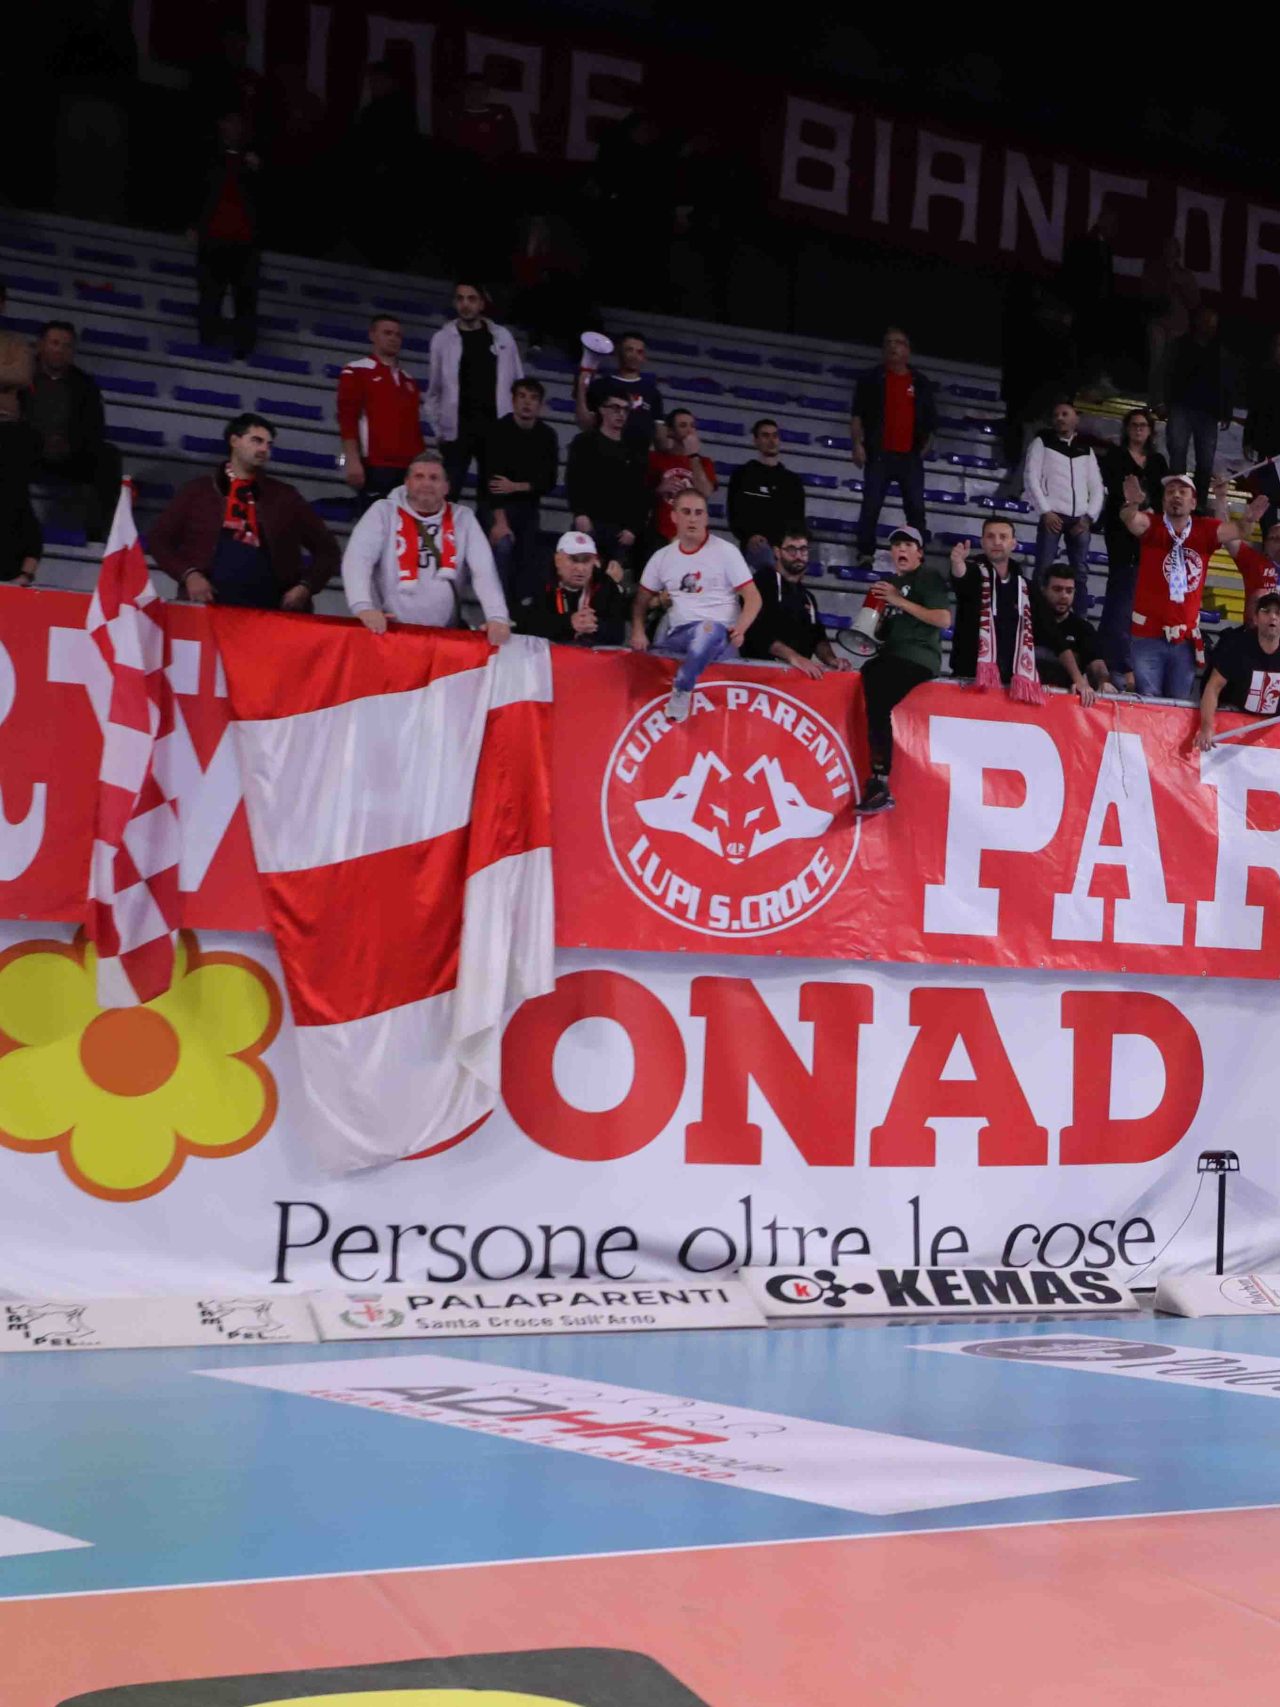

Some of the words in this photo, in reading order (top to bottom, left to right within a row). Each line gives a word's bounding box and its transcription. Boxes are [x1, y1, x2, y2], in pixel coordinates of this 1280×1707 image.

[615, 691, 716, 784] CURA
[726, 687, 851, 799] PARENTI
[627, 834, 702, 921] LUPI
[270, 1200, 639, 1284] Persone
[677, 1194, 871, 1278] oltre
[908, 1194, 970, 1267] le
[1001, 1216, 1157, 1270] cose
[406, 1288, 731, 1310] PALAPARENTI
[876, 1269, 1123, 1306] KEMAS
[416, 1316, 481, 1329] Santa
[487, 1316, 554, 1328] Croce
[560, 1313, 657, 1327] Sull'Arno
[446, 1417, 523, 1435] PER
[575, 1446, 738, 1480] LAVORO
[658, 1447, 787, 1475] GROUP
